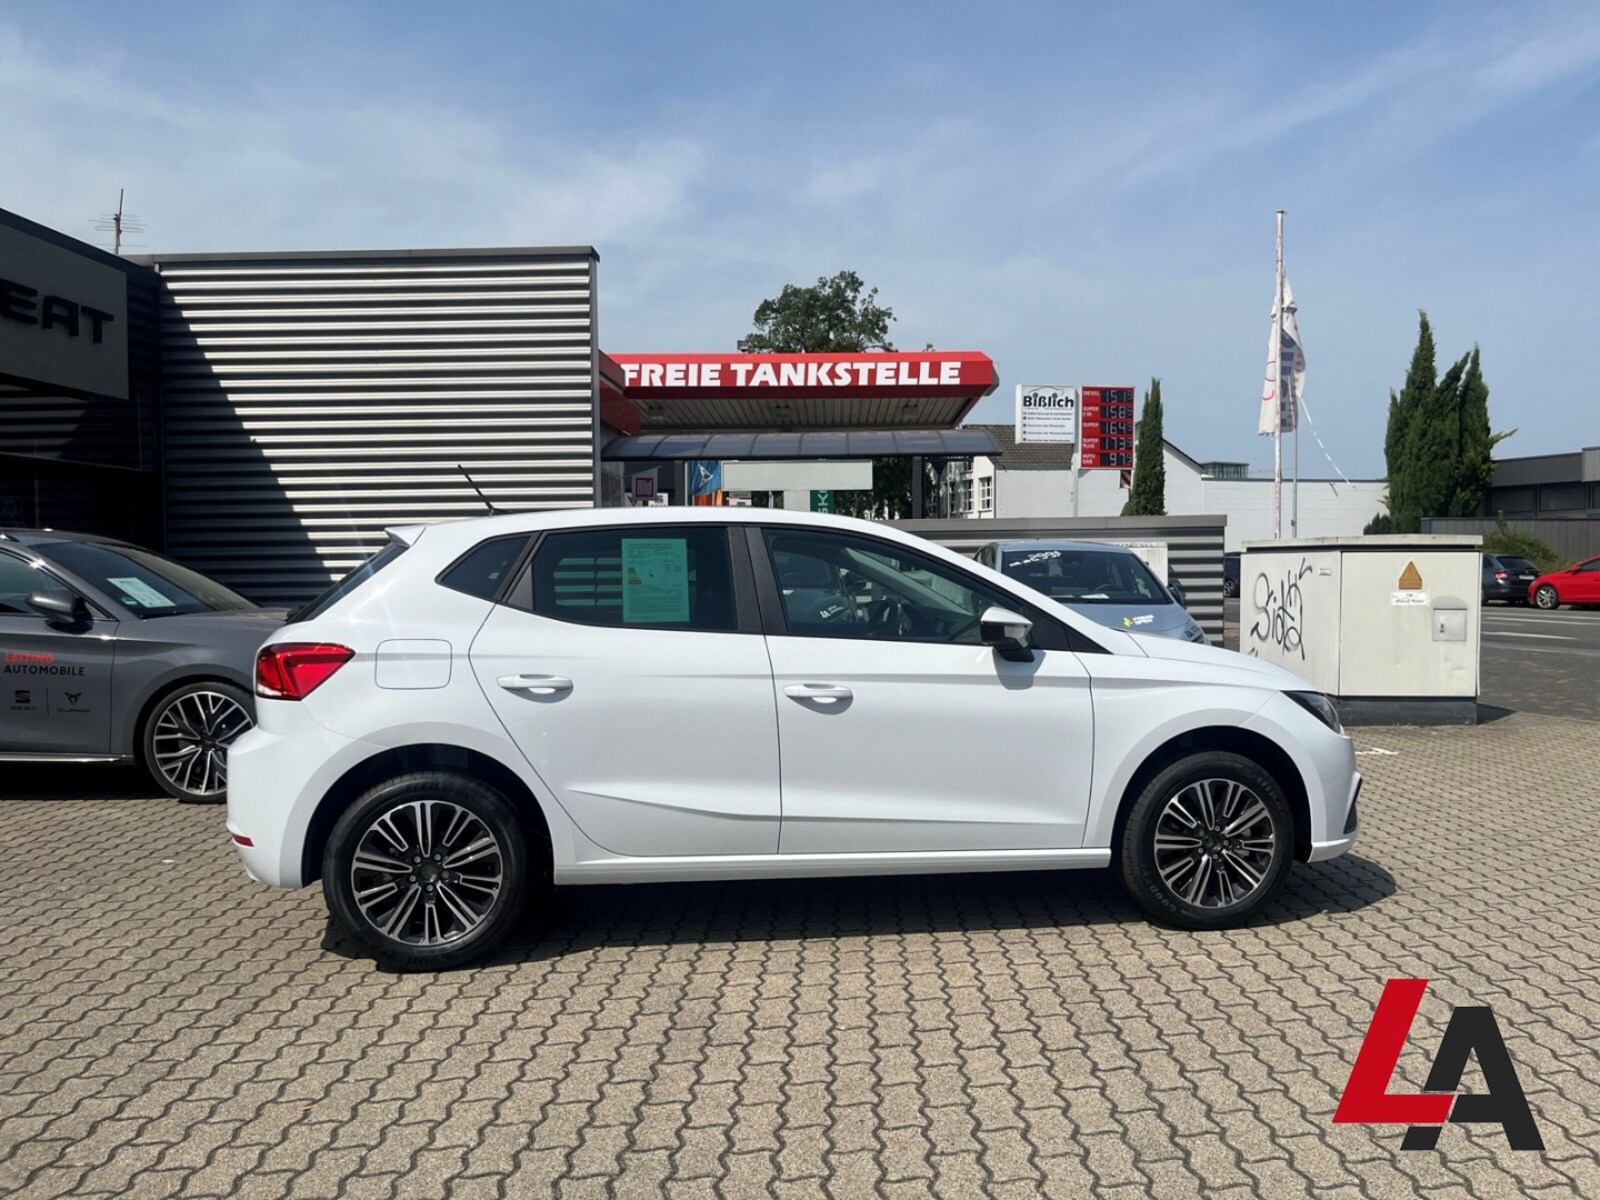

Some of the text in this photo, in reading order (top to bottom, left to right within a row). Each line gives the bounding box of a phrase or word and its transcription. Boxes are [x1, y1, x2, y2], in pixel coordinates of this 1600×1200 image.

[620, 361, 962, 387] FREIE TANKSTELLE
[1023, 392, 1074, 408] Bißlich
[4, 652, 55, 664] LEITING
[4, 664, 86, 676] AUTOMOBILE
